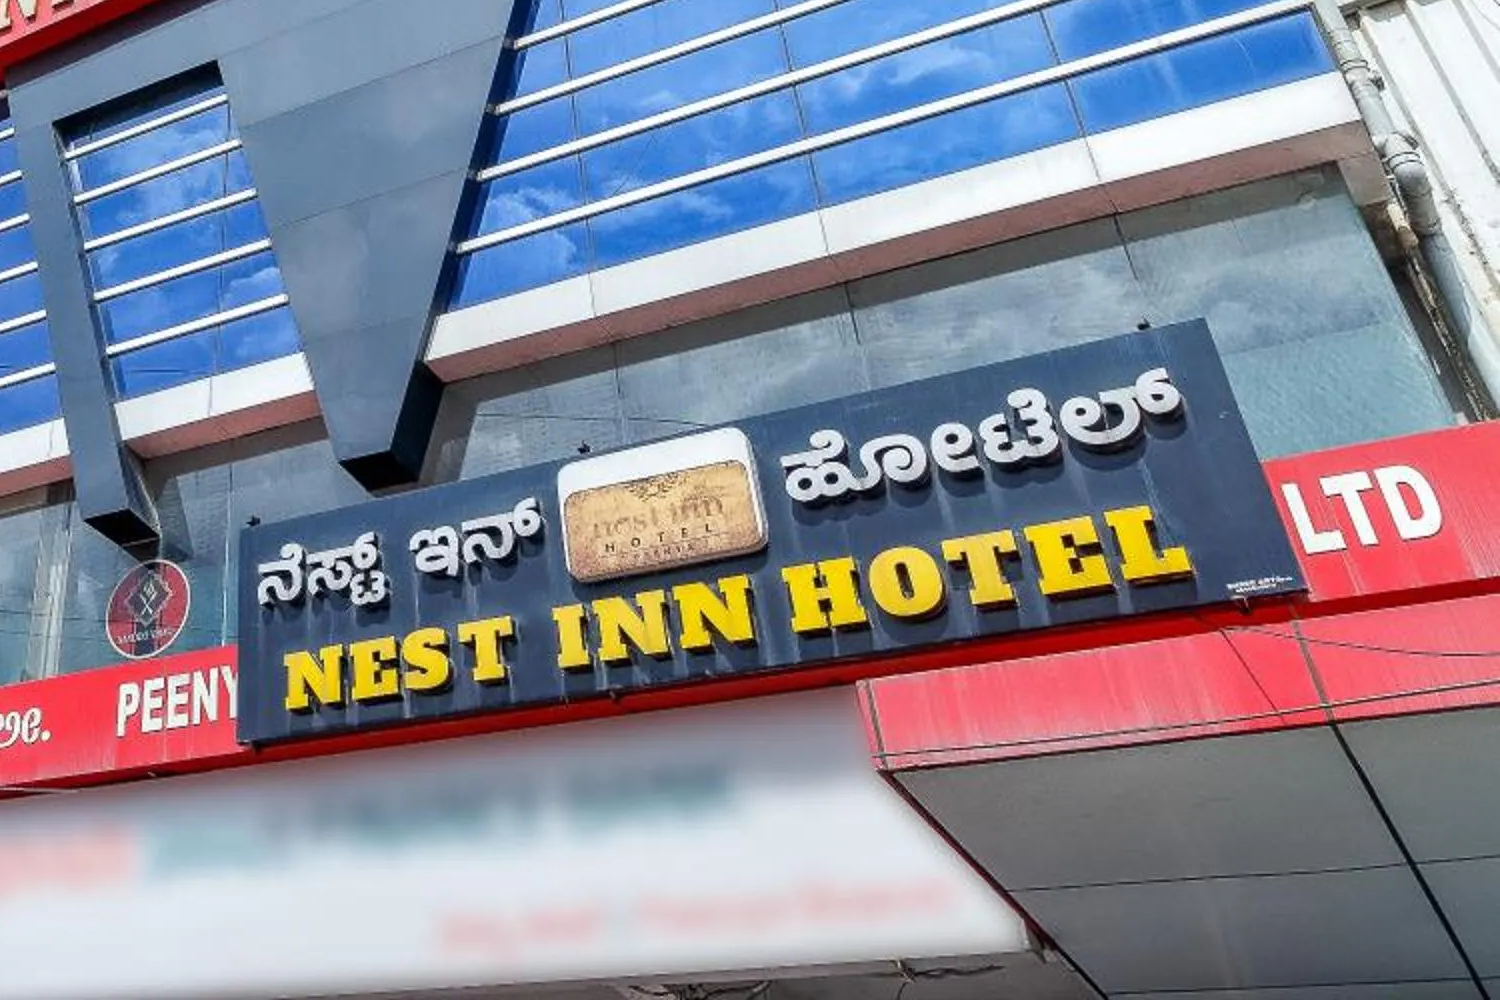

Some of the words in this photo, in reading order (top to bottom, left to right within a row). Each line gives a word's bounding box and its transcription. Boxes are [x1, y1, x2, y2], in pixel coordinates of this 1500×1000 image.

[258, 531, 387, 605] ನೆಸ್ಟ್
[409, 497, 541, 576] ಇನ್
[780, 367, 1183, 503] ಹೋಟೆಲ್
[605, 523, 713, 553] HOTEL
[1281, 465, 1443, 555] LTD
[284, 615, 514, 712] NEST
[552, 573, 756, 671] INN
[781, 505, 1193, 635] HOTEL
